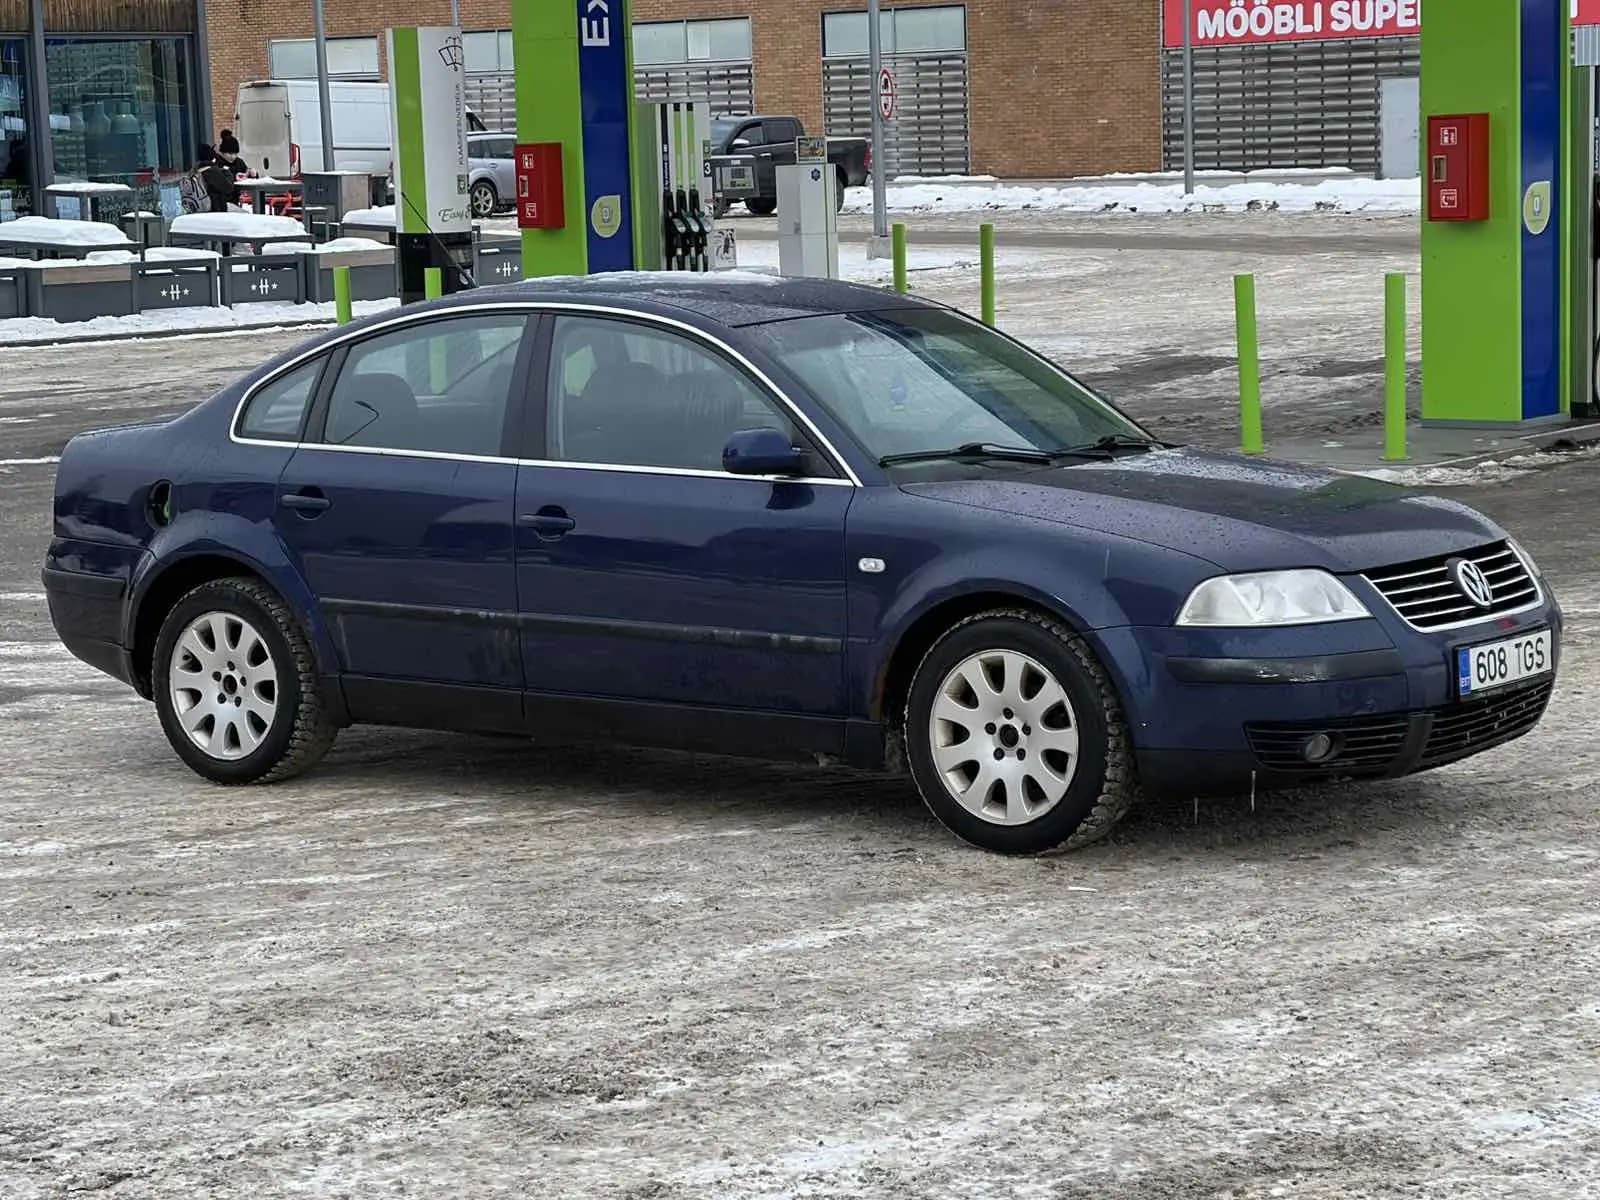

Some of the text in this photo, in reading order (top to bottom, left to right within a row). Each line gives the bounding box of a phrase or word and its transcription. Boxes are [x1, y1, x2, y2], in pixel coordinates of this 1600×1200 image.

[1197, 0, 1421, 39] MÖÖBLI SUPE
[704, 162, 712, 175] 3
[1476, 637, 1545, 683] 608 TGS
